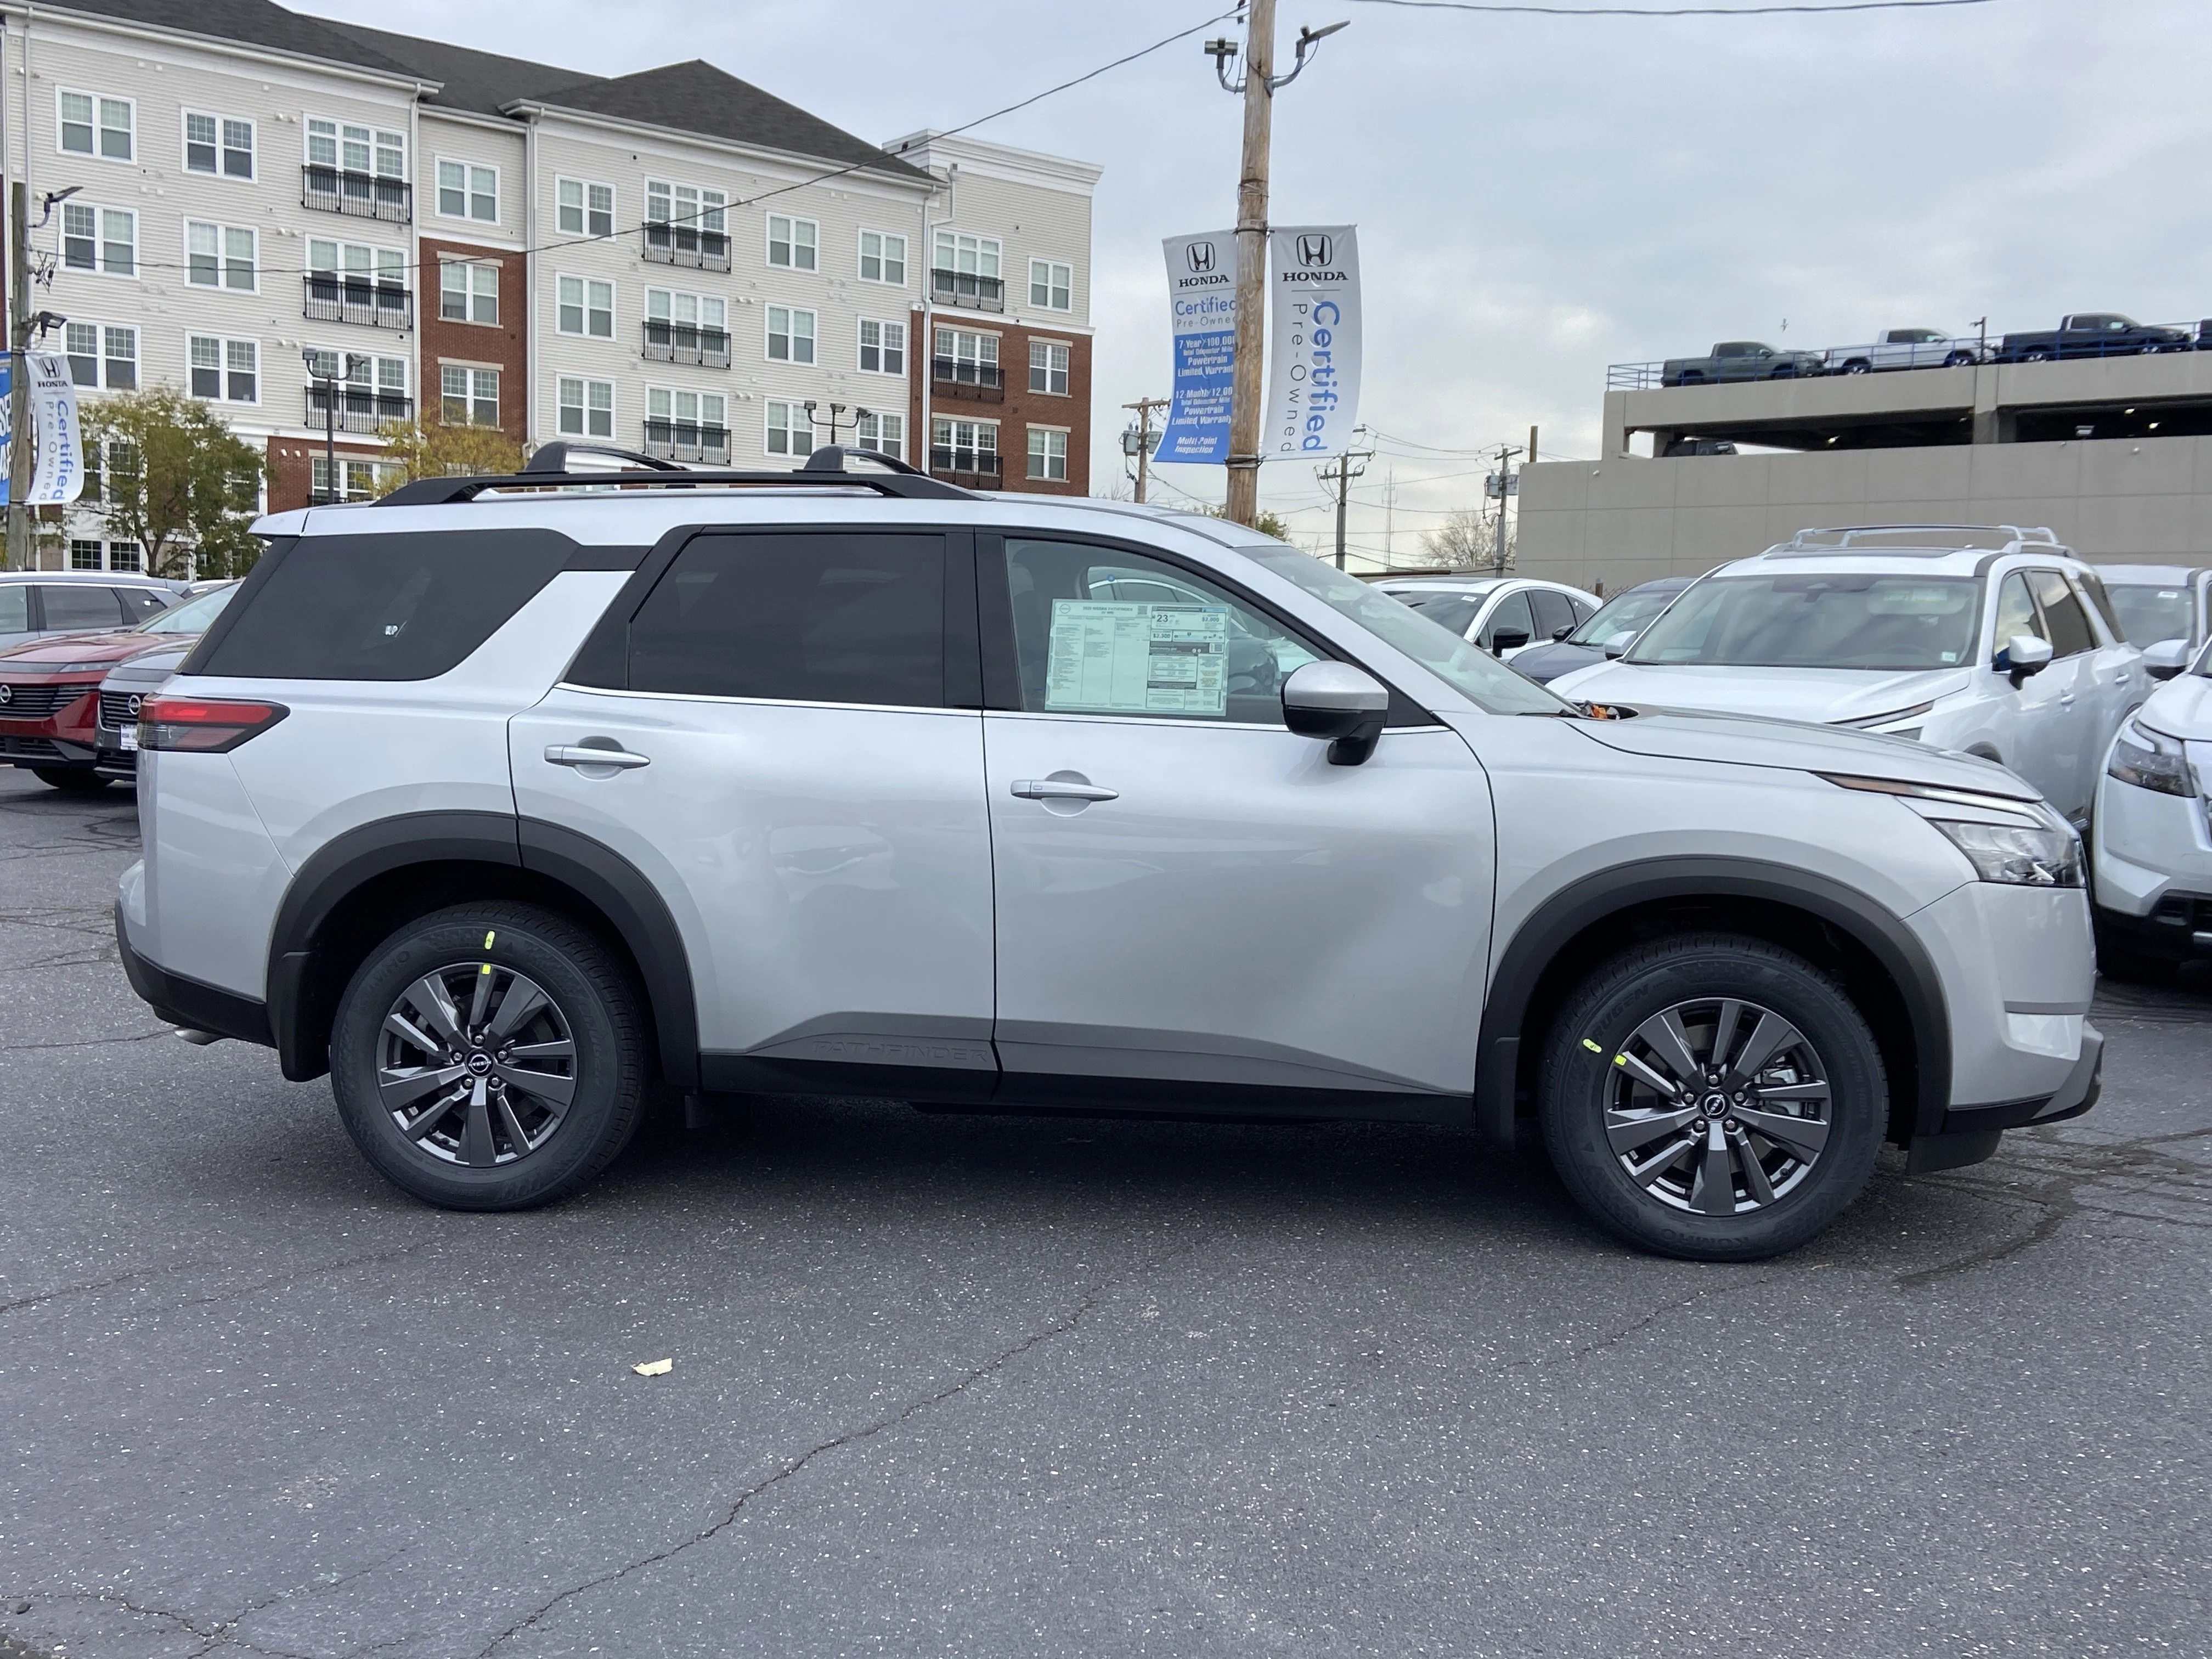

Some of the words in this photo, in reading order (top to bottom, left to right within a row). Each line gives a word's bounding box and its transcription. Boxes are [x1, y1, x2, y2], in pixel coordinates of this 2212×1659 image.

[1178, 274, 1231, 288] HONDA
[1282, 272, 1349, 283] HONDA
[1188, 354, 1228, 366] Powertrain
[1177, 366, 1203, 377] Limited
[1280, 303, 1307, 452] Pre-Owned
[1301, 301, 1340, 452] Certified
[1183, 405, 1224, 415] Powertrain
[1172, 416, 1198, 425] Limited
[1200, 415, 1232, 424] Warranty
[38, 400, 58, 500] Pre-Owned
[50, 399, 74, 500] Certified
[1174, 445, 1214, 454] Inspection
[1156, 614, 1169, 623] 23
[814, 1040, 988, 1063] PATHFINDER
